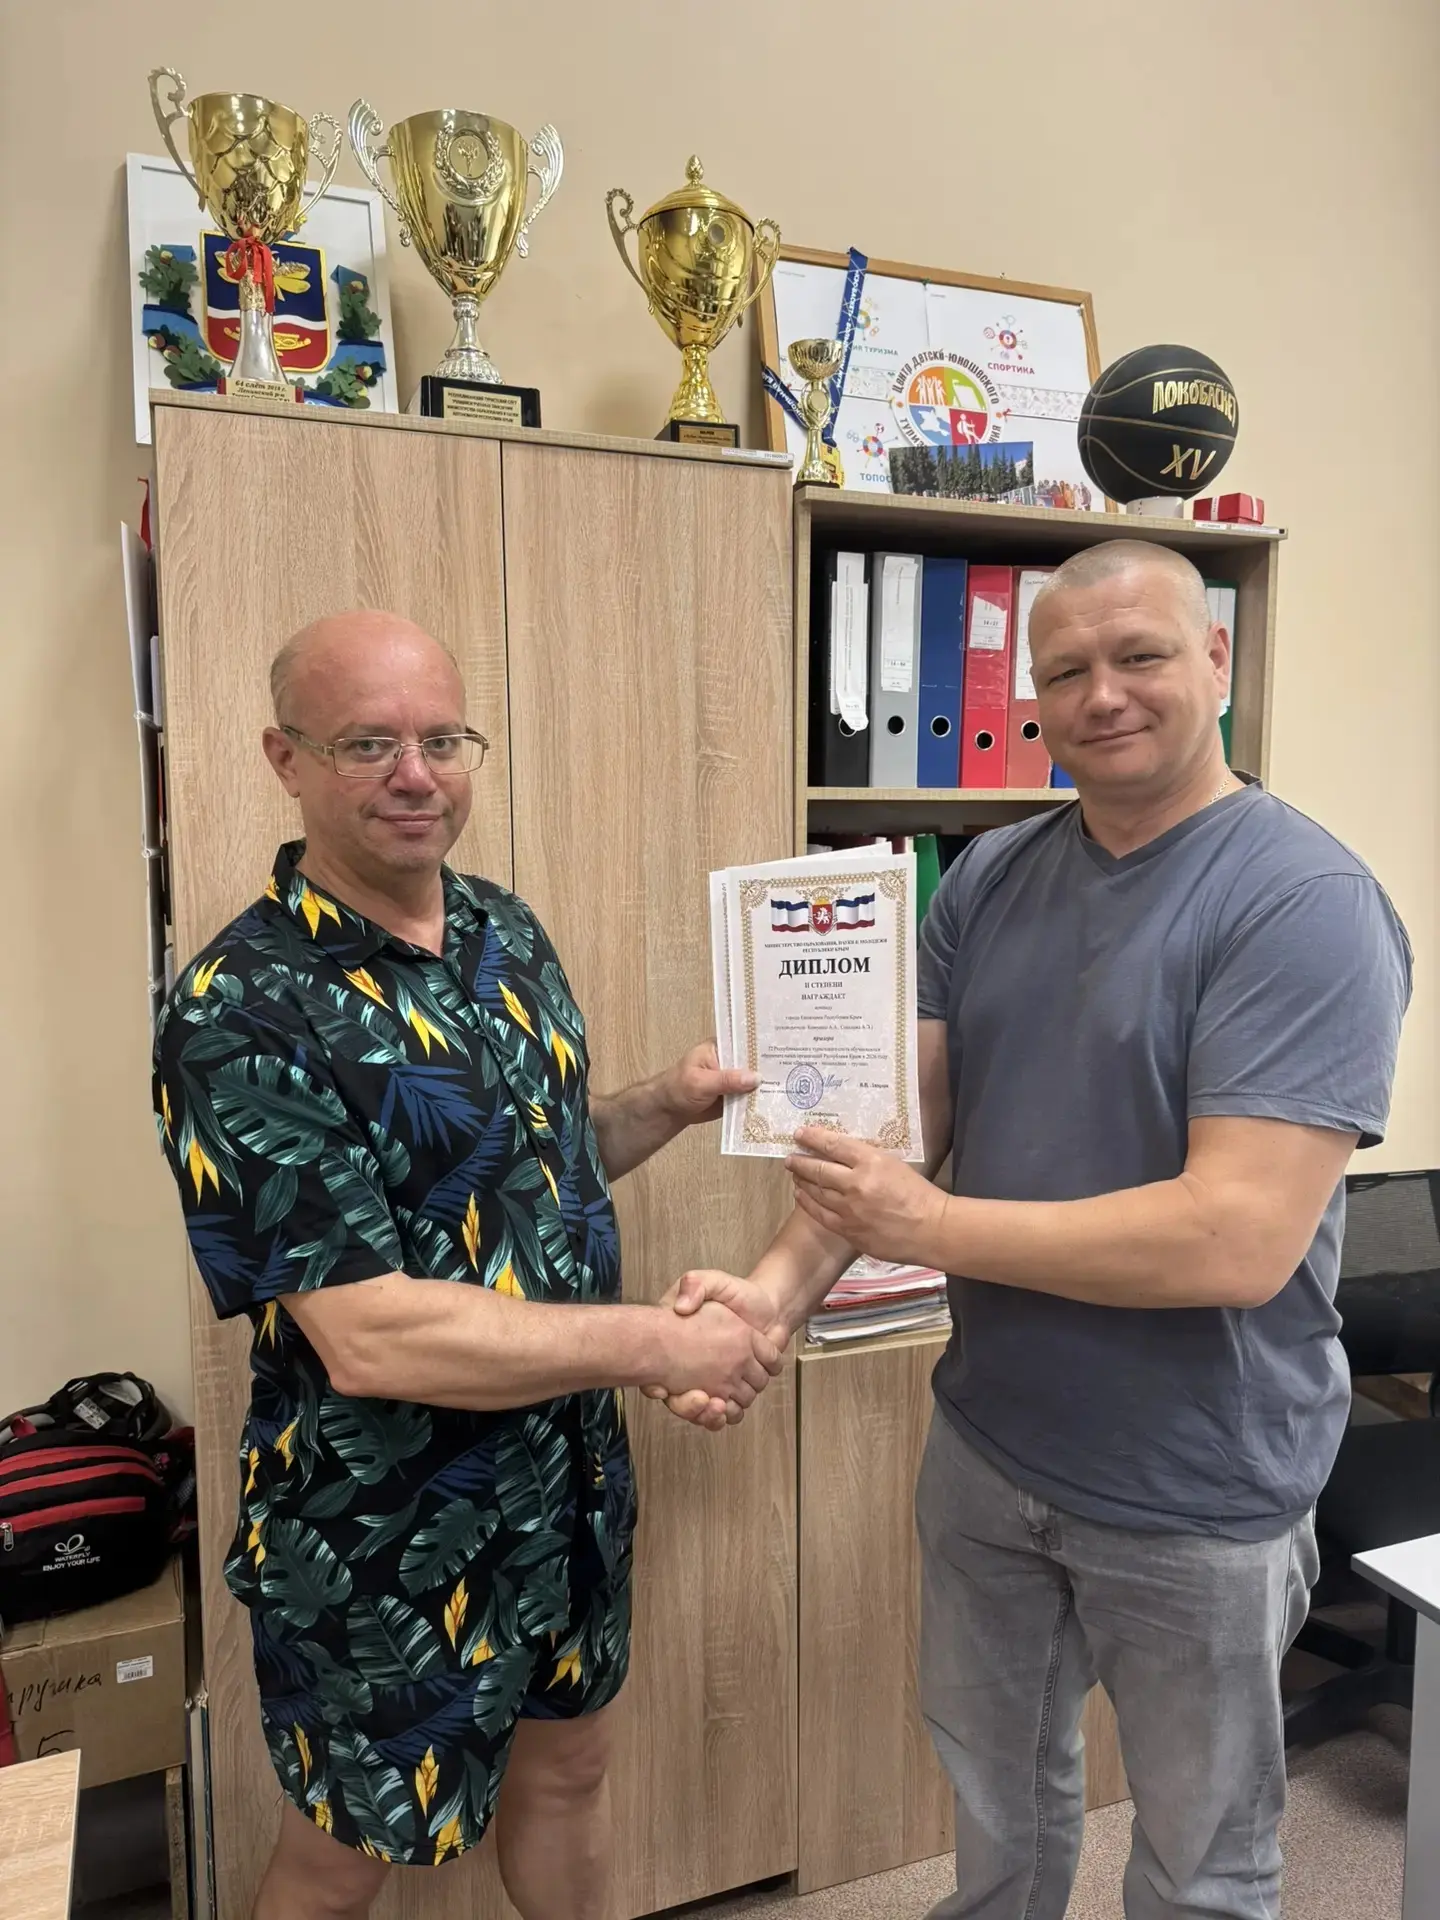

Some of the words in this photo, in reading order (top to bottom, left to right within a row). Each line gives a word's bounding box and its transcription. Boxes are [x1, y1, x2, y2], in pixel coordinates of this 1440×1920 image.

[988, 362, 1035, 375] СПОРТИКА
[1160, 444, 1216, 480] XV
[860, 472, 892, 483] ТОПОС
[778, 957, 871, 979] ДИПЛОМ
[55, 1552, 90, 1562] WATERFLY
[43, 1563, 65, 1571] ENJOY
